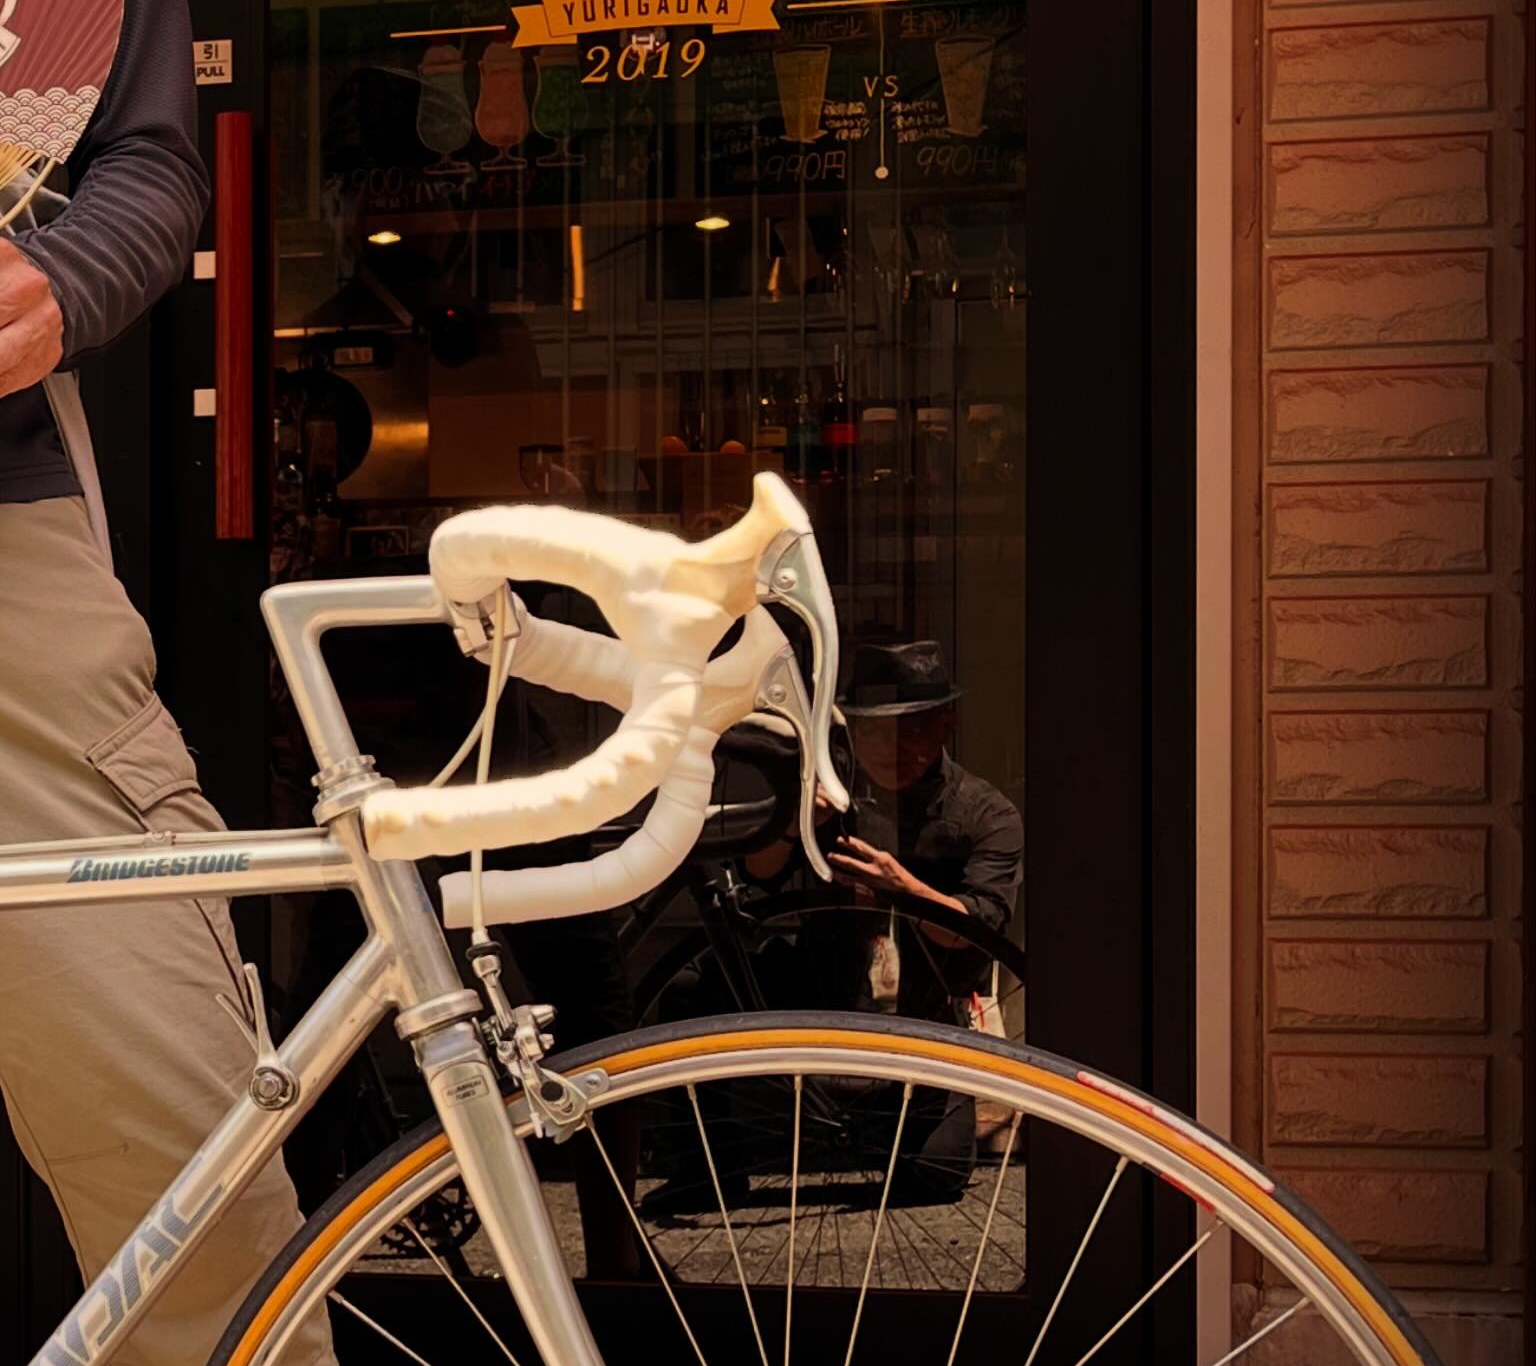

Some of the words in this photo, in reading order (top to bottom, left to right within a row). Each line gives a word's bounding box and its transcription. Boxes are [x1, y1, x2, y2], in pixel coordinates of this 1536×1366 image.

[196, 66, 225, 77] PULL
[580, 38, 706, 84] 2019
[66, 851, 252, 883] BRIDGESTONE
